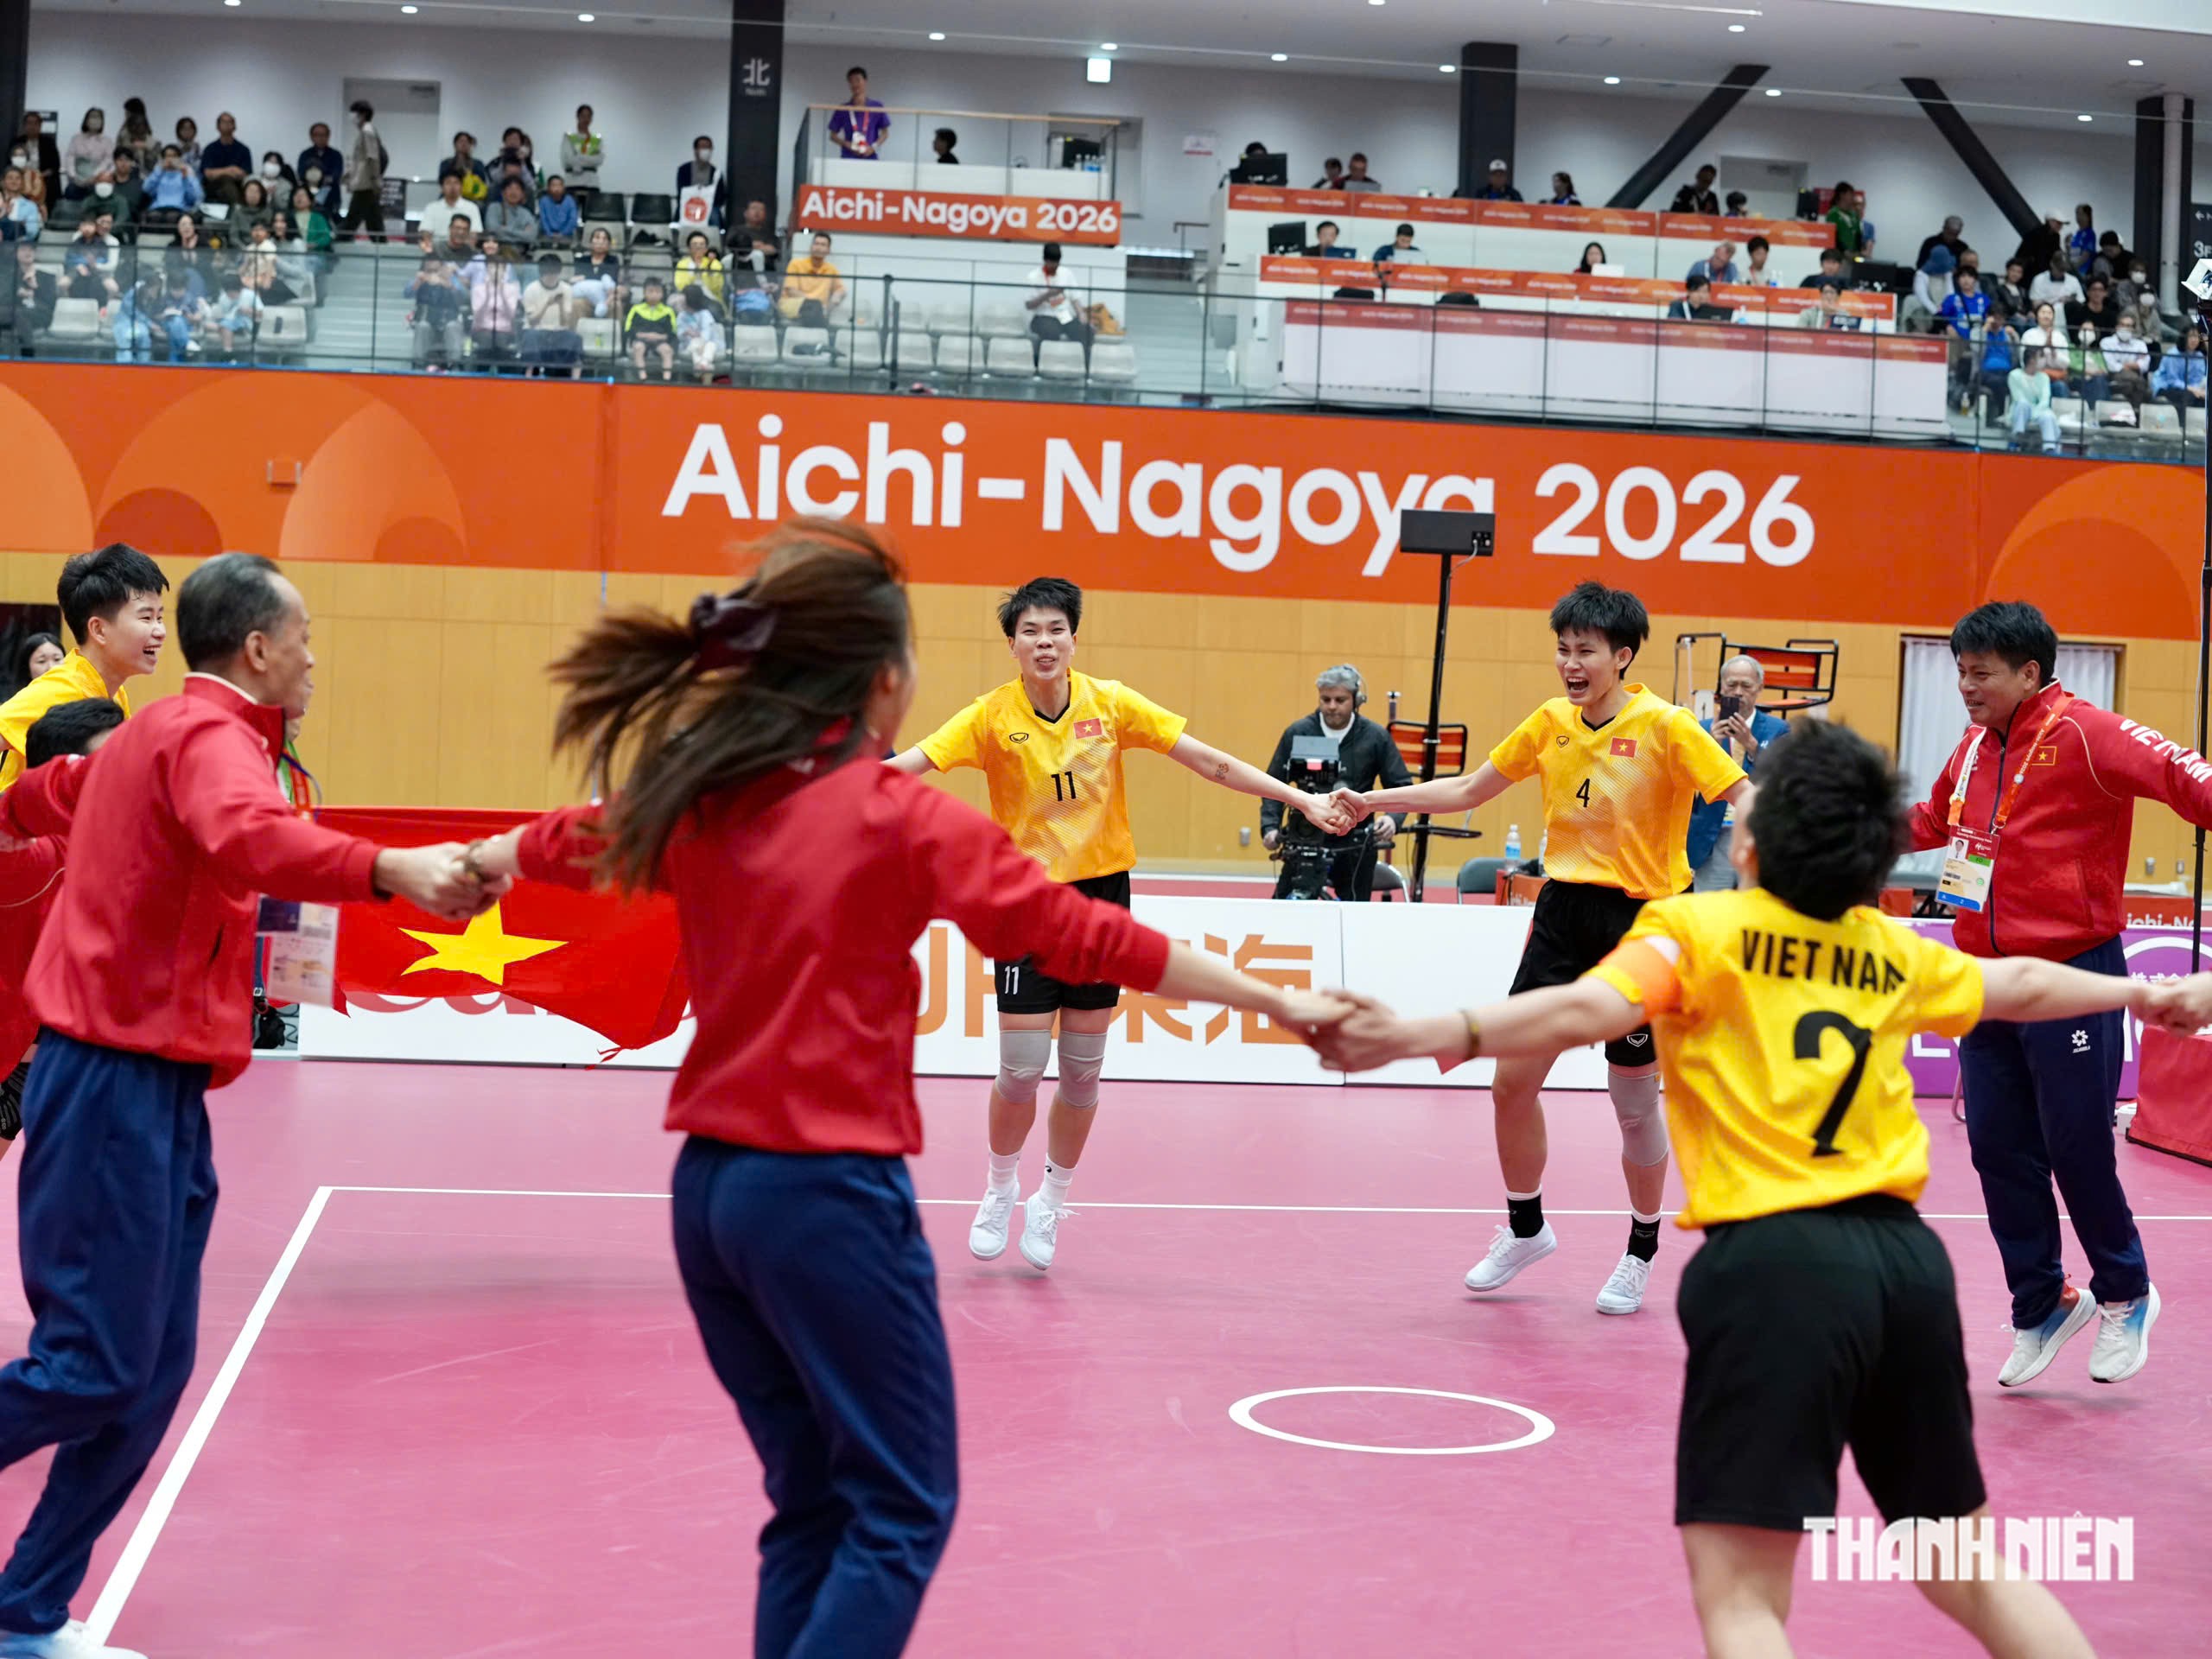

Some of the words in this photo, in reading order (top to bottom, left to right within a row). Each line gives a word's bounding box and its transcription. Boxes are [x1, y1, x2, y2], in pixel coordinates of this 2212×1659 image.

[742, 58, 771, 86] 北
[801, 190, 1027, 234] Aichi-Nagoya
[1036, 203, 1118, 233] 2026
[1532, 462, 1815, 567] 2026
[1051, 771, 1077, 802] 11
[1575, 778, 1590, 808] 4
[1743, 928, 1821, 980] VIET
[1004, 965, 1020, 995] 11
